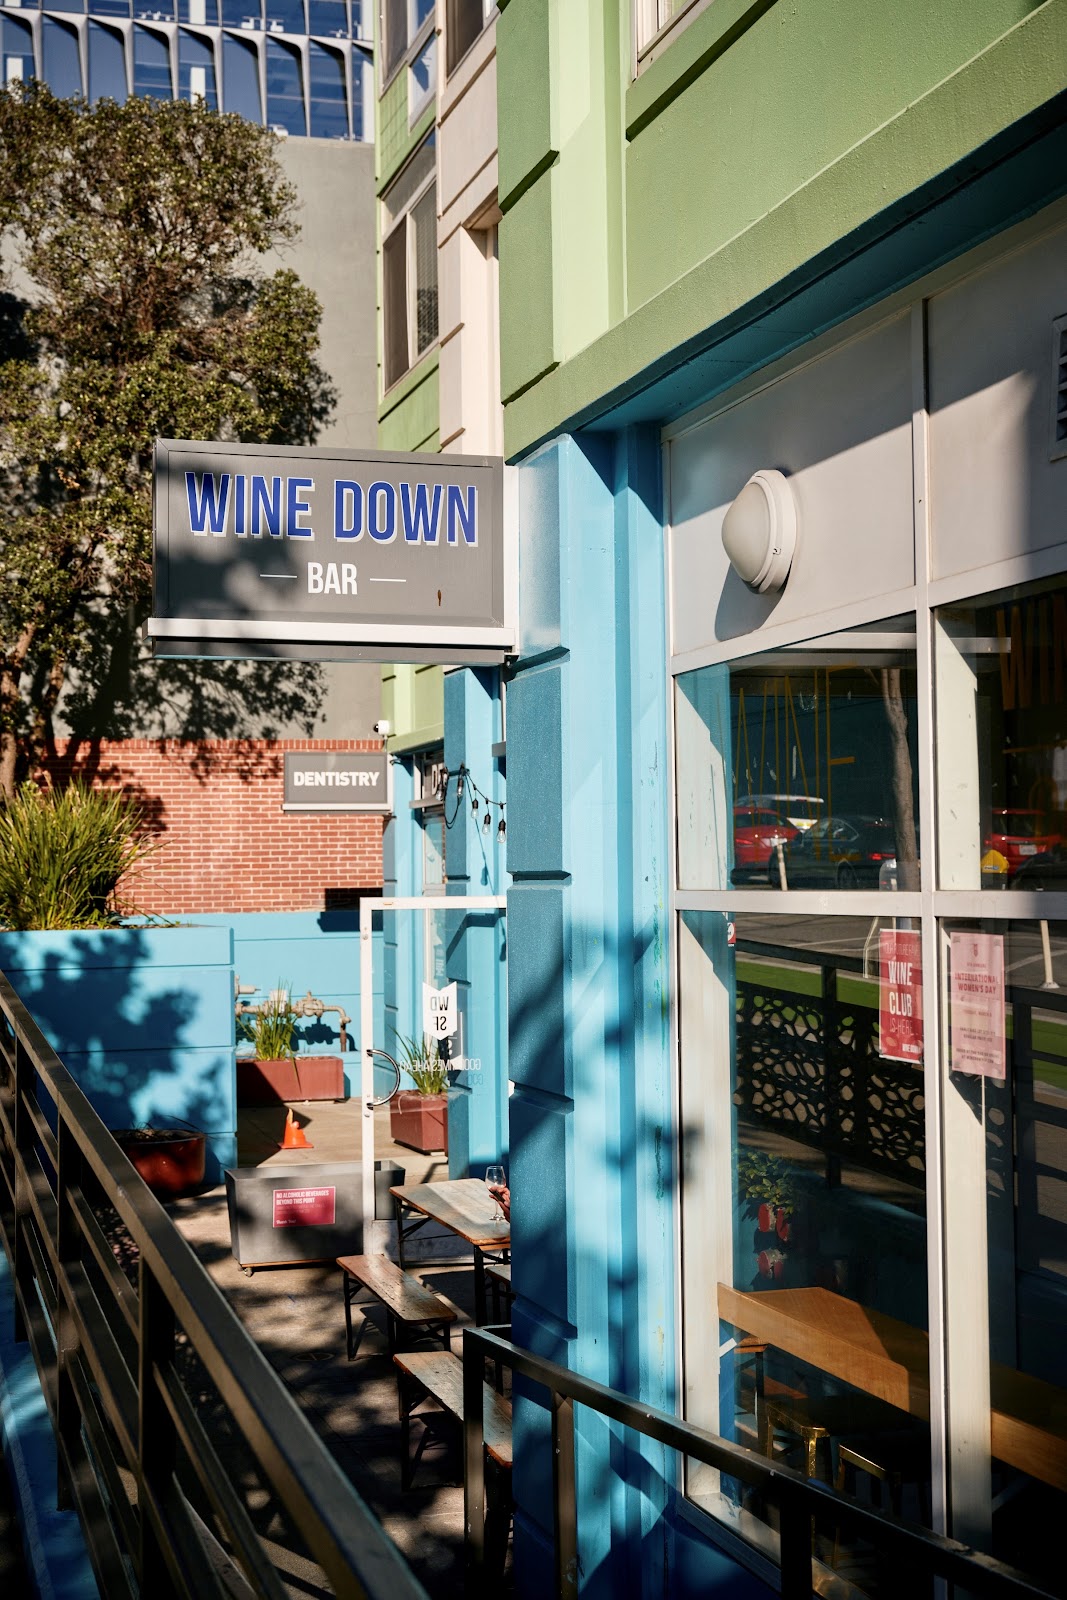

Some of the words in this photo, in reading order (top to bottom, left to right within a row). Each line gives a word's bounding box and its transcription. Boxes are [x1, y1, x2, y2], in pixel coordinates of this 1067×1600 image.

[185, 471, 315, 540] WINE
[334, 478, 480, 548] DOWN
[307, 562, 358, 596] BAR
[293, 770, 380, 787] DENTISTRY
[888, 961, 913, 986] WINE
[955, 972, 998, 984] INTERNATIONAL
[958, 983, 984, 993] WOMEN'S
[985, 985, 996, 994] DAY
[889, 991, 912, 1017] CLUB
